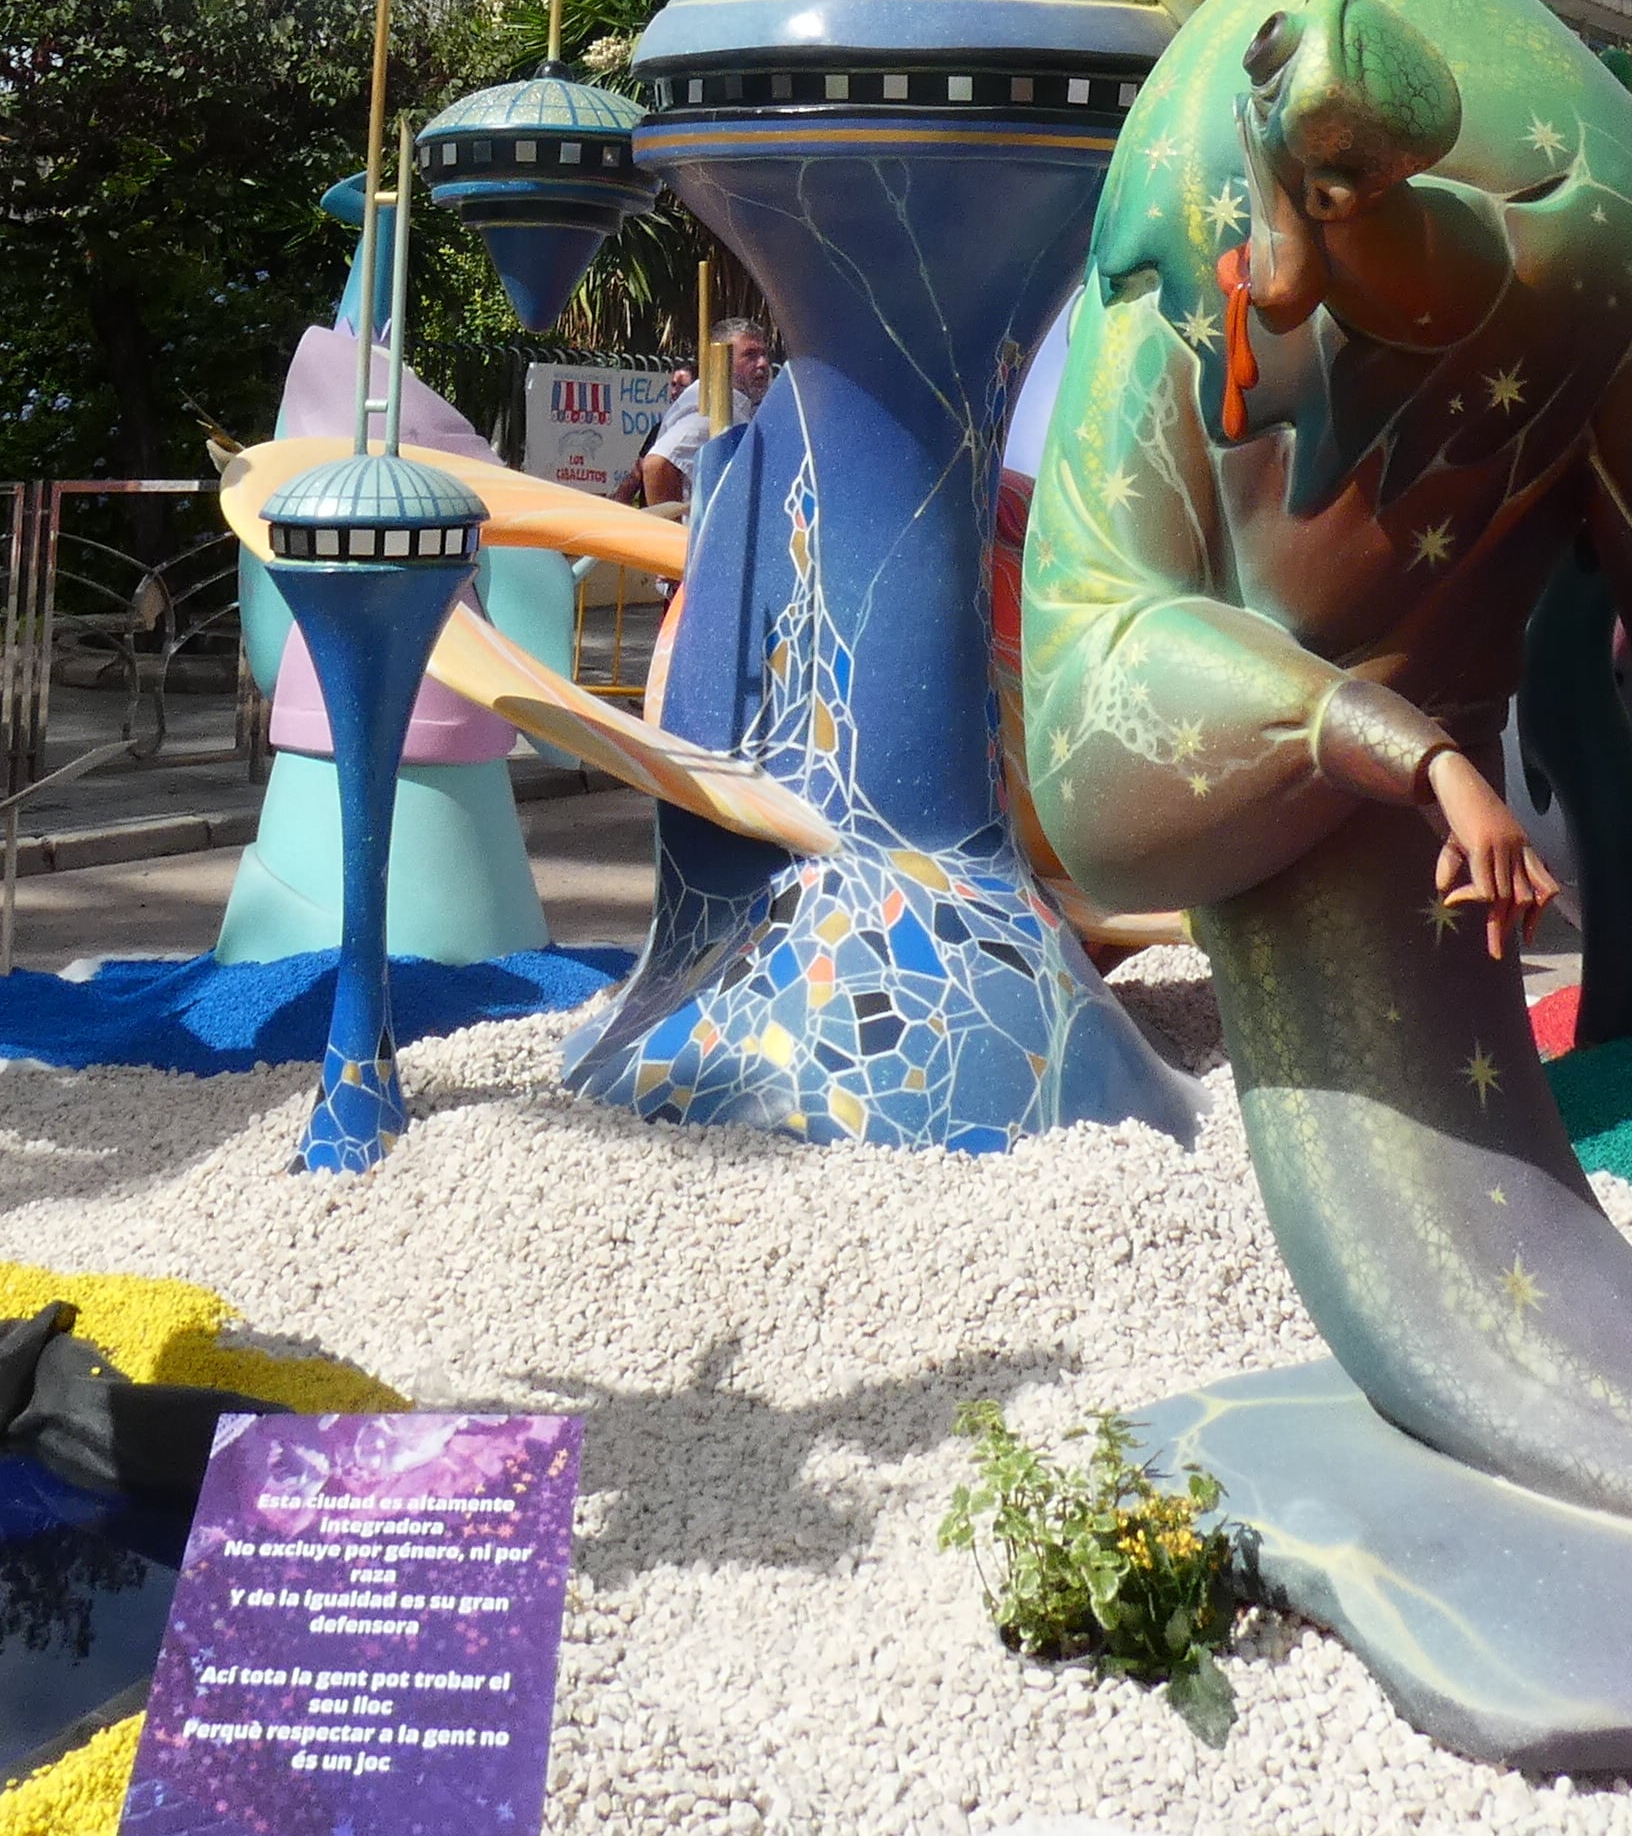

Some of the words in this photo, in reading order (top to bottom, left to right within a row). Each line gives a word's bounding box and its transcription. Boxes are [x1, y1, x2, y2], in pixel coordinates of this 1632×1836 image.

[620, 377, 672, 404] HELA
[621, 410, 662, 435] DON
[258, 1493, 300, 1510] Esta
[303, 1494, 375, 1511] ciudad
[380, 1497, 404, 1511] es
[407, 1495, 515, 1512] altamente
[320, 1517, 444, 1537] integradora
[224, 1540, 256, 1556] No
[259, 1542, 343, 1560] excluye
[346, 1544, 382, 1561] por
[385, 1543, 465, 1563] género,
[469, 1544, 491, 1559] ni
[494, 1546, 532, 1563] por
[350, 1568, 396, 1584] raza
[230, 1589, 245, 1606] Y
[248, 1590, 275, 1606] de
[279, 1590, 300, 1607] la
[303, 1591, 396, 1611] igualdad
[400, 1594, 426, 1609] es
[429, 1595, 456, 1609] su
[459, 1596, 509, 1613] gran
[309, 1616, 420, 1634] defensora
[200, 1667, 237, 1684] Ací
[239, 1668, 287, 1686] tota
[291, 1669, 312, 1686] la
[316, 1670, 369, 1691] gent
[371, 1672, 412, 1691] pot
[414, 1672, 483, 1690] trobar
[483, 1673, 510, 1690] el
[308, 1696, 349, 1714] seu
[352, 1696, 393, 1715] lloc
[183, 1720, 262, 1741] Perquè
[267, 1723, 375, 1747] respectar
[378, 1729, 394, 1744] a
[397, 1726, 419, 1745] la
[423, 1729, 477, 1749] gent
[481, 1731, 509, 1745] no
[291, 1752, 321, 1770] és
[323, 1755, 352, 1771] un
[353, 1753, 391, 1775] joc
